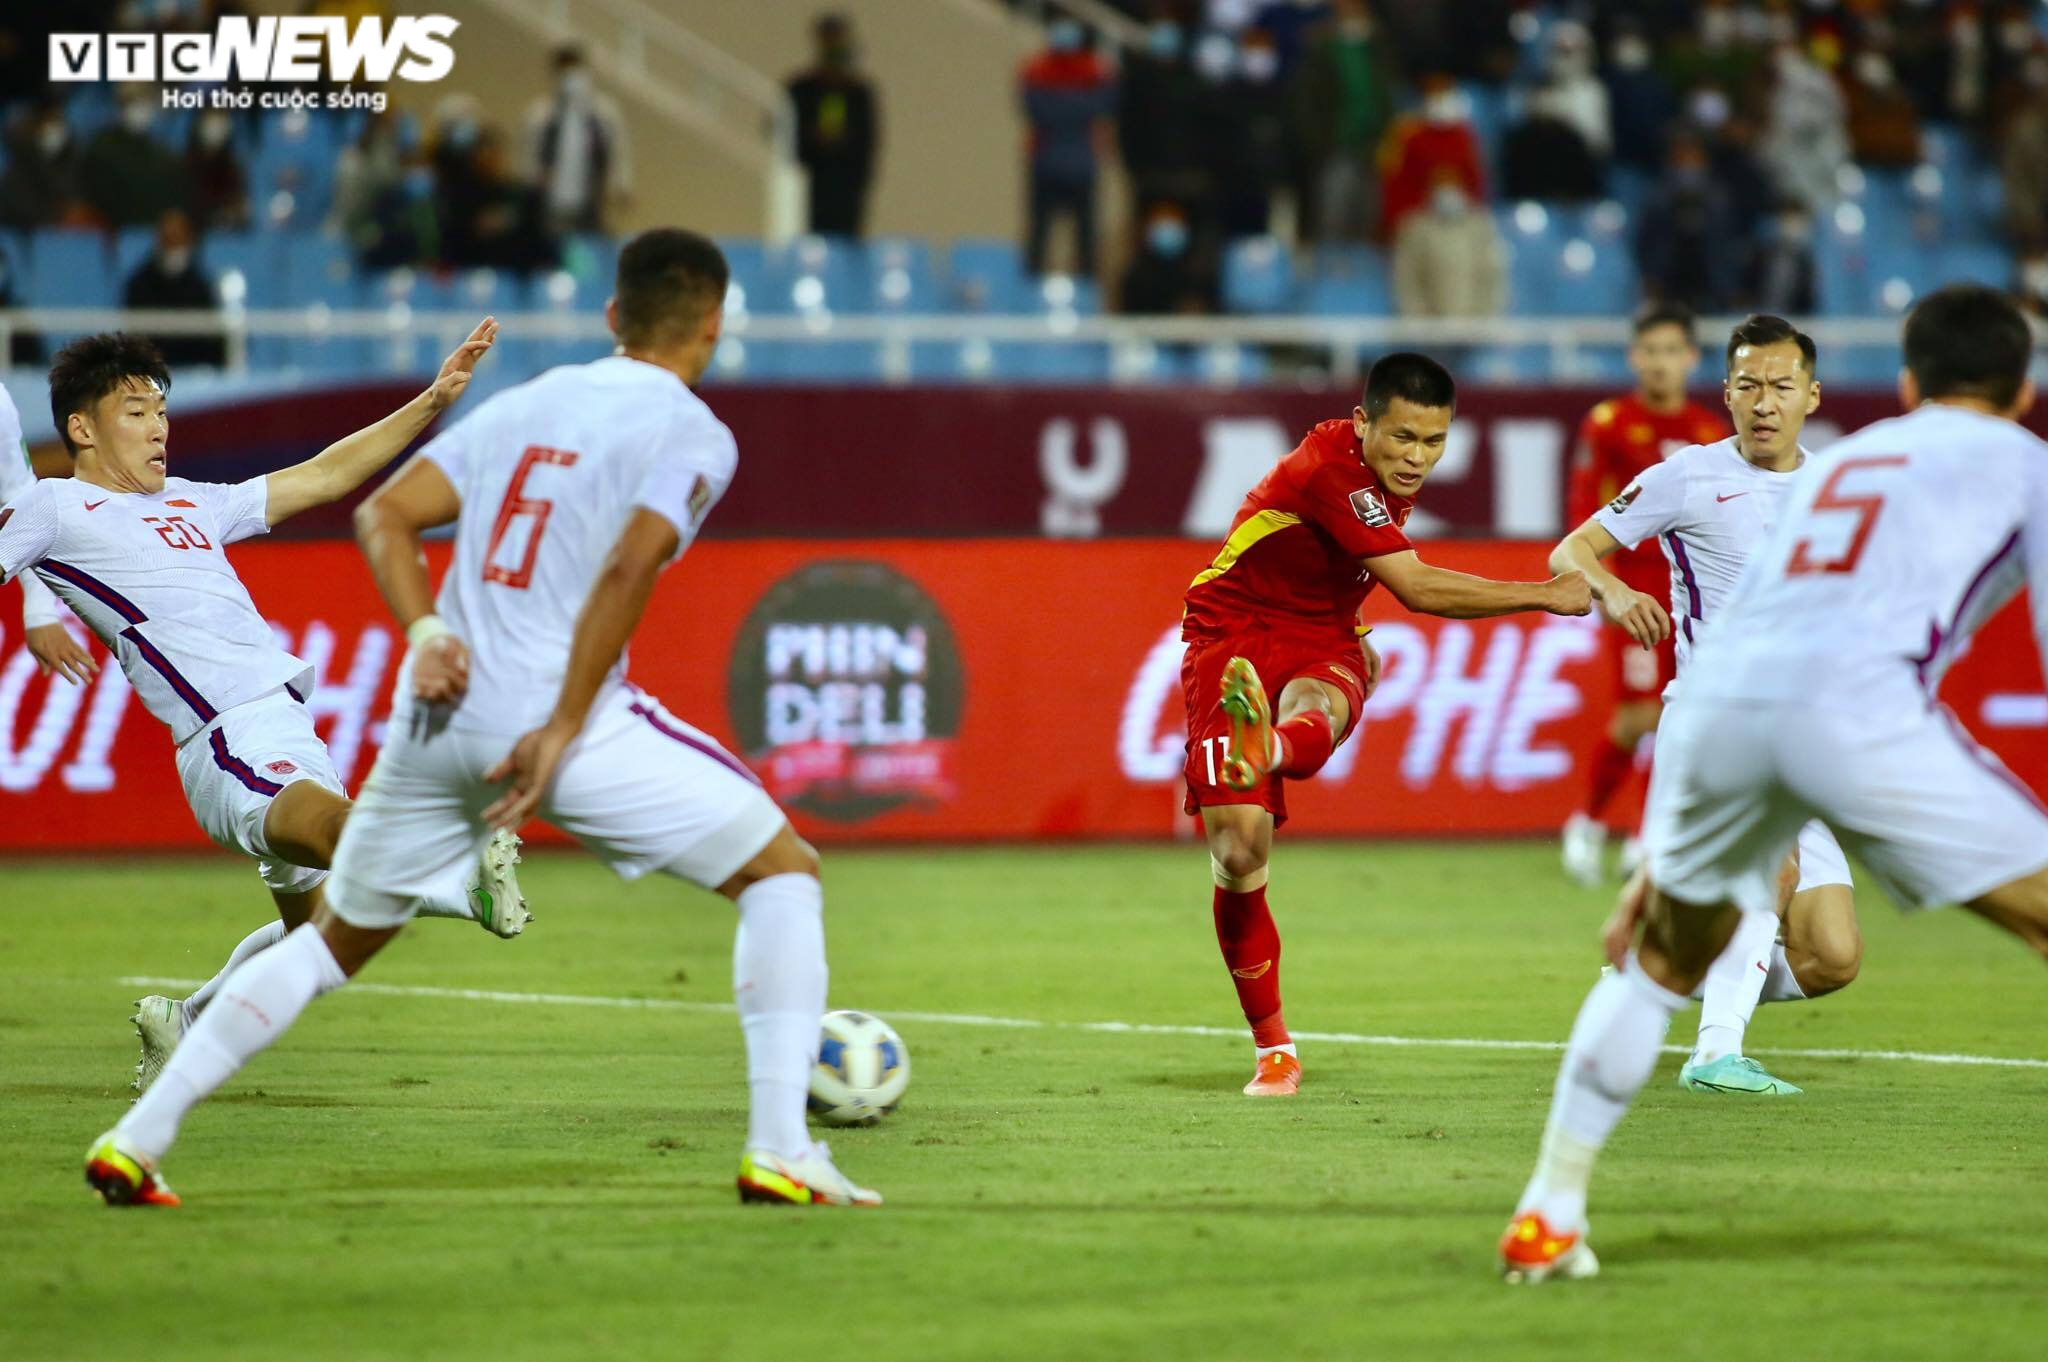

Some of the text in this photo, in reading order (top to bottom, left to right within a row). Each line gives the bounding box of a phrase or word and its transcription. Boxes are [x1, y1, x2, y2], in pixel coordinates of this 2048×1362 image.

[141, 515, 213, 551] 20
[483, 443, 579, 591] 6
[1785, 455, 1910, 578] 5
[766, 682, 927, 746] DELI
